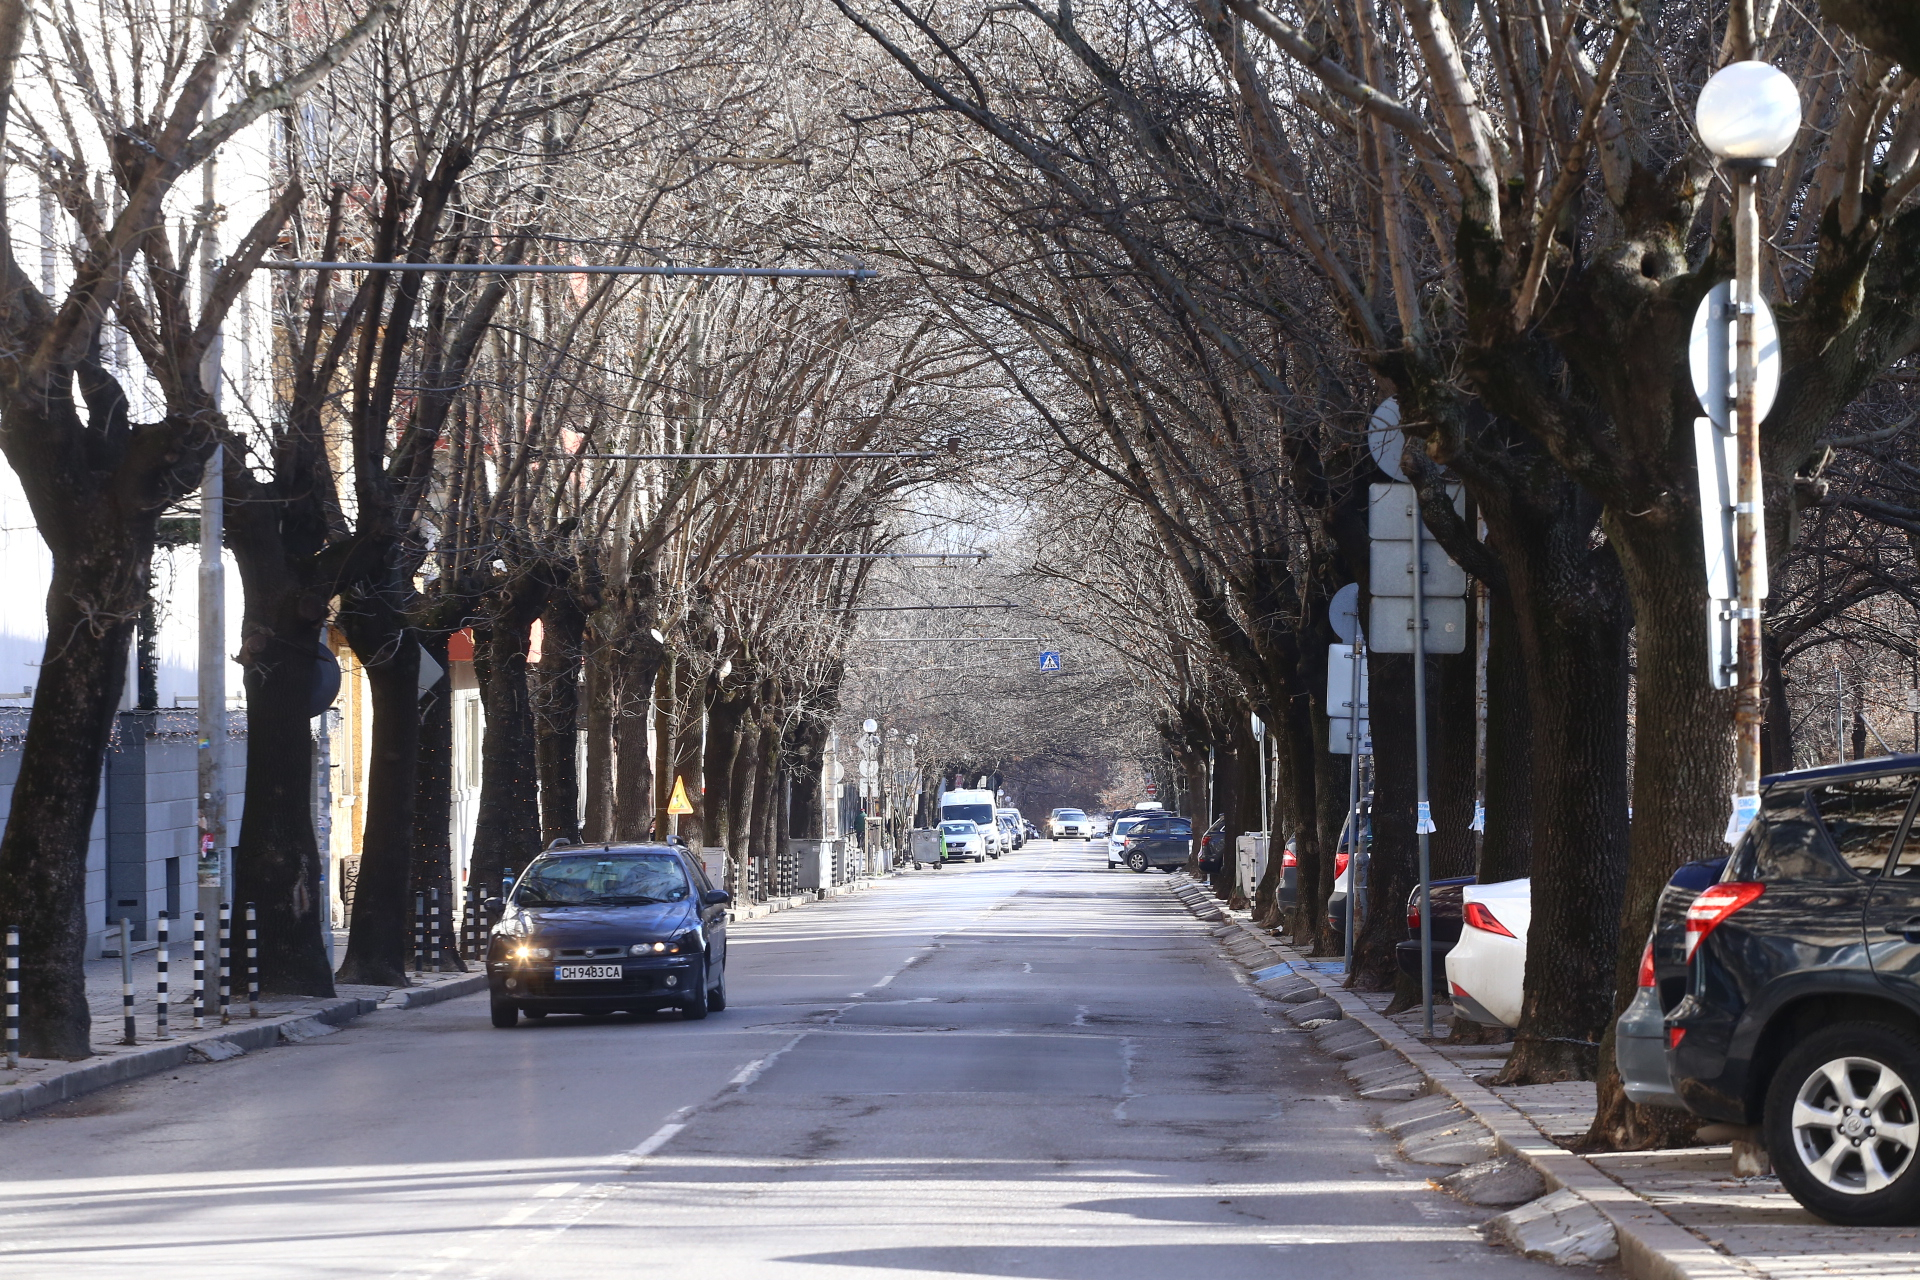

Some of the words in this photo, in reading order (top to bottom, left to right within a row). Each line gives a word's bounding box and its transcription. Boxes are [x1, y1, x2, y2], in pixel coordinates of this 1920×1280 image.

[562, 967, 576, 978] CH
[578, 967, 604, 978] 9483
[606, 966, 620, 978] CA
